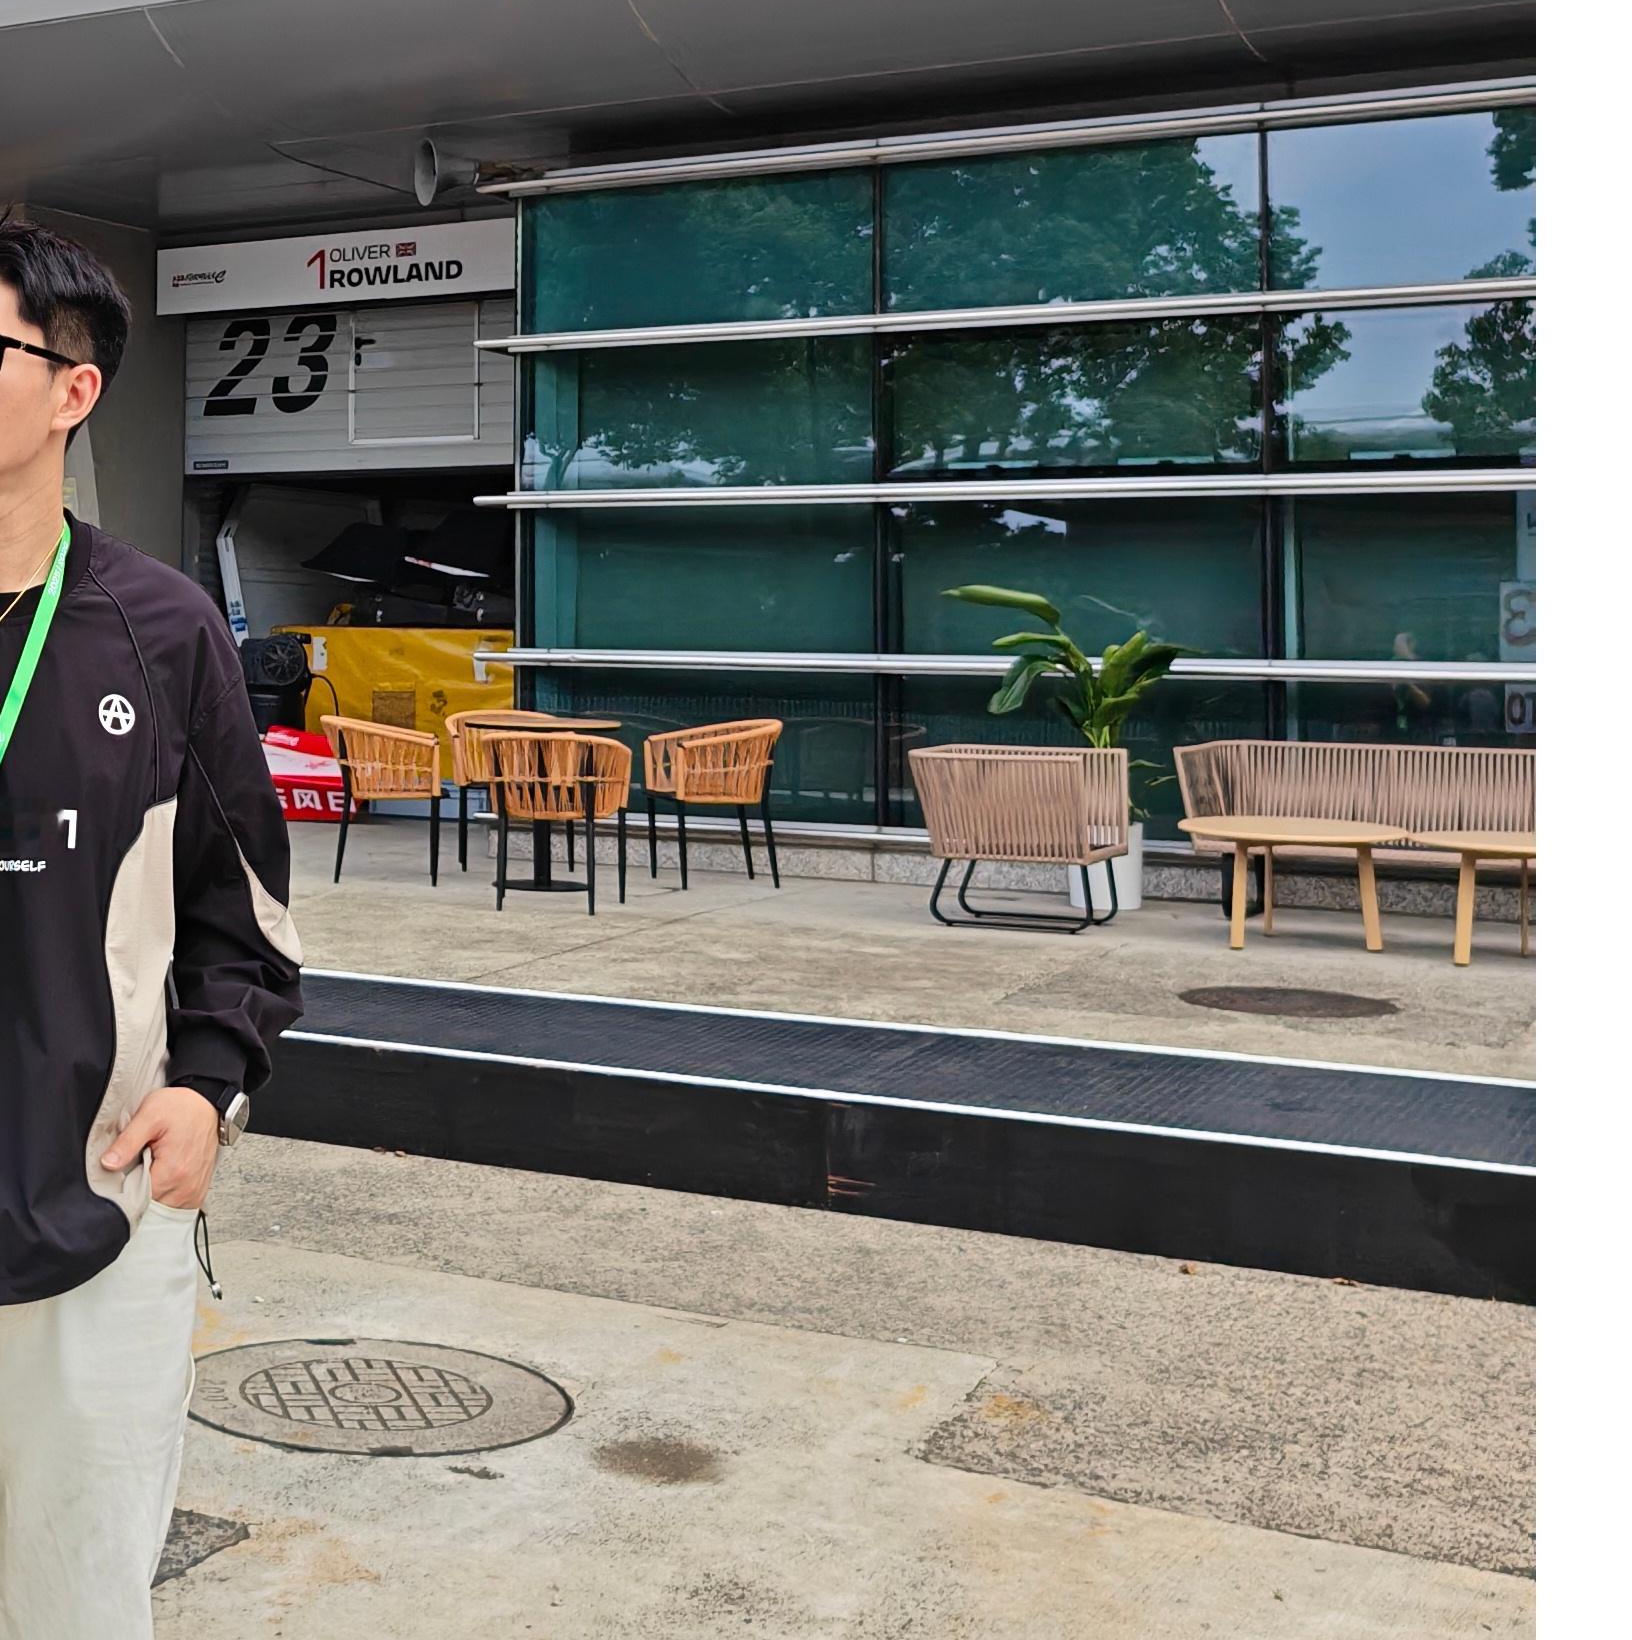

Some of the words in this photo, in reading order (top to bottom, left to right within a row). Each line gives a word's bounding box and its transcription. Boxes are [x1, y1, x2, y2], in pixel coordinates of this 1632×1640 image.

[306, 249, 326, 290] 1
[329, 244, 391, 264] OLIVER
[329, 259, 463, 289] ROWLAND
[203, 314, 338, 417] 23
